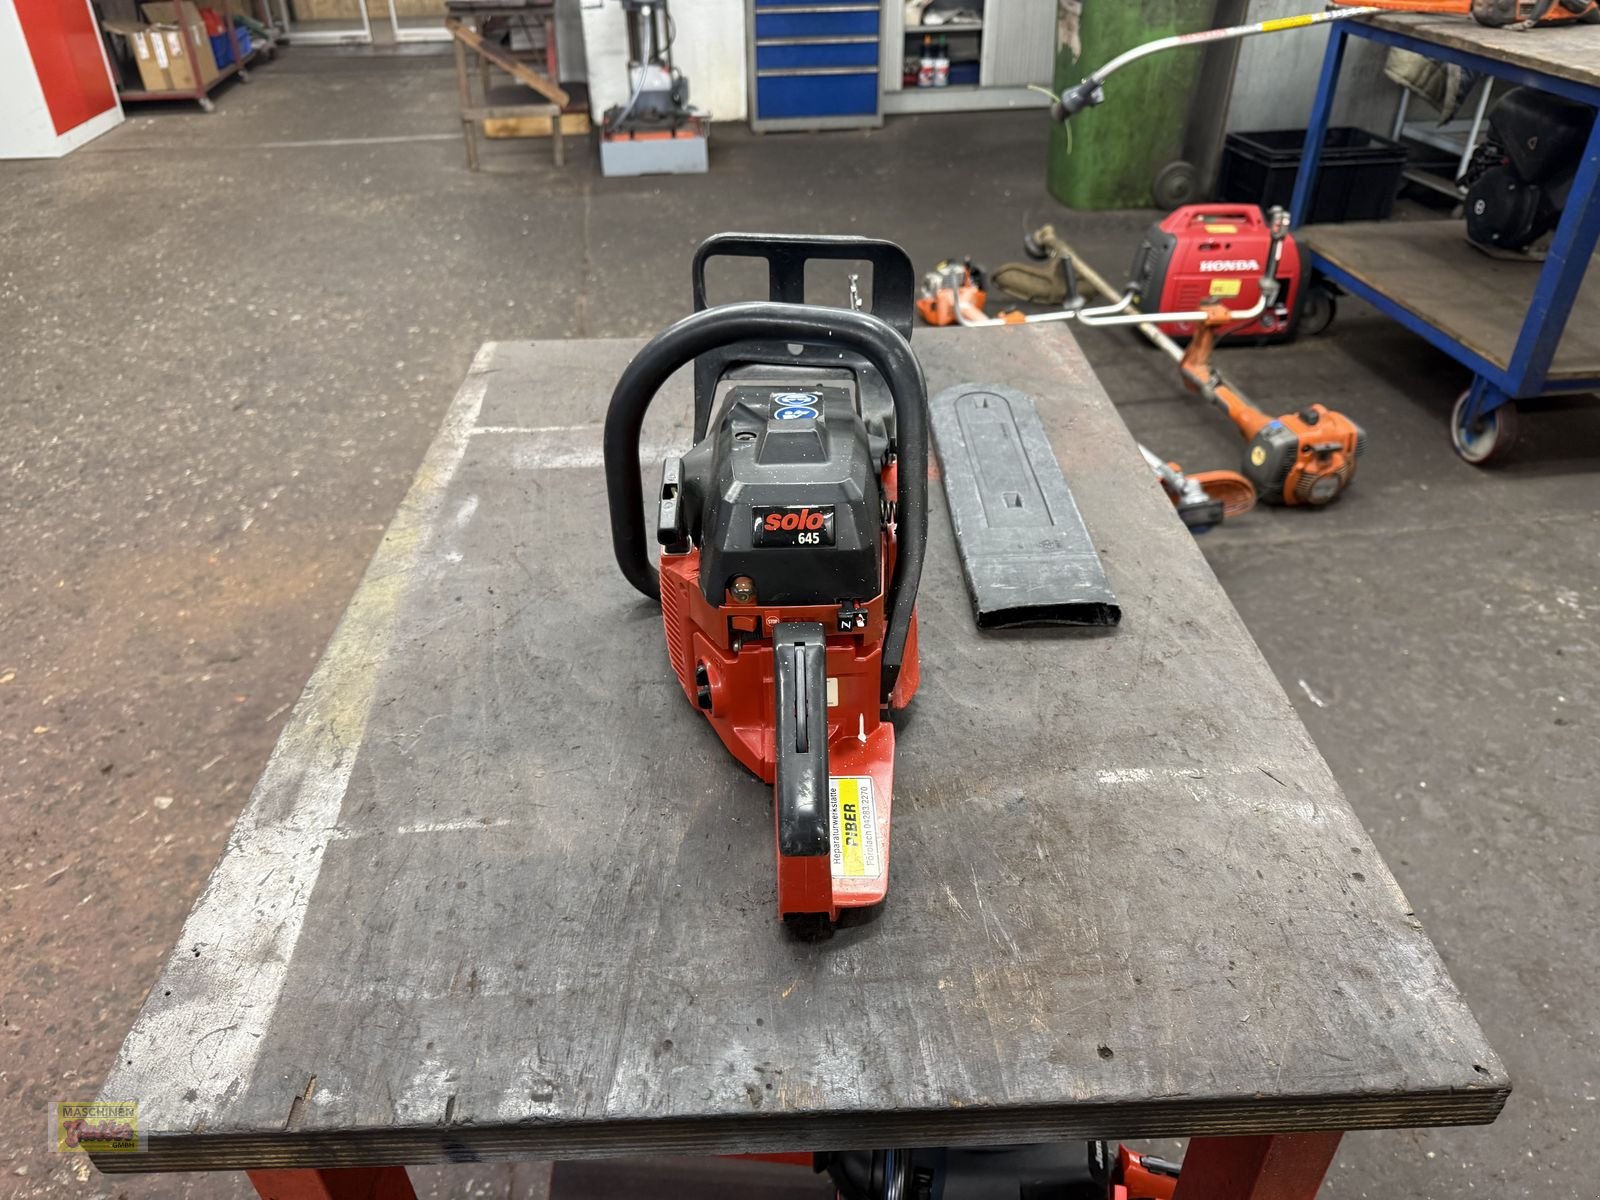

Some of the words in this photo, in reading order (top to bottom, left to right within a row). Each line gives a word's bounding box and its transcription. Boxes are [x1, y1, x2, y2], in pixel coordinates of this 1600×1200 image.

[1200, 259, 1260, 272] HONDA
[764, 509, 824, 531] solo
[798, 532, 820, 545] 645
[843, 803, 858, 846] PIBER
